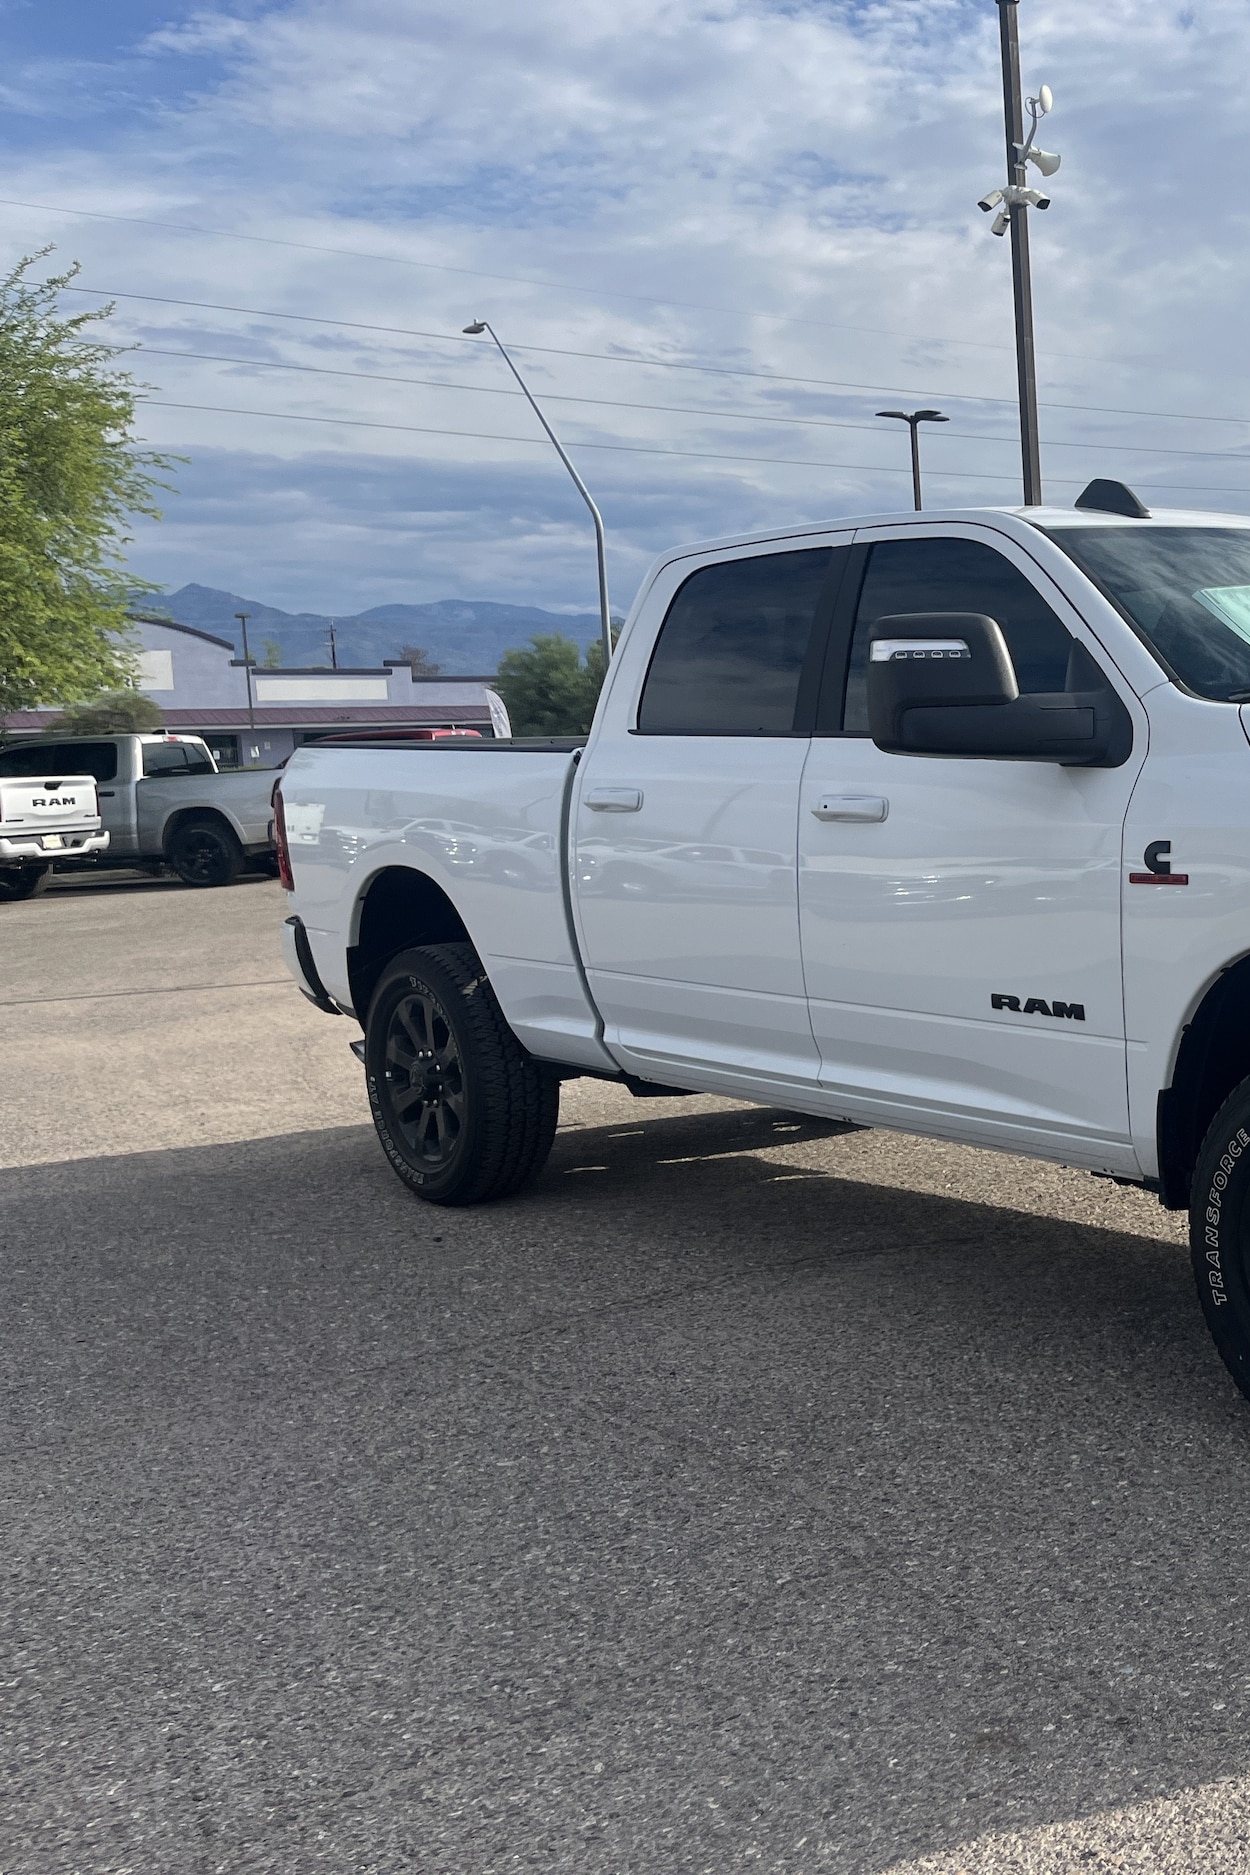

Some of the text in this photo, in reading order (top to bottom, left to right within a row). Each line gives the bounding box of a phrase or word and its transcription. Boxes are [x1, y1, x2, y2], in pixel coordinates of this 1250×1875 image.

[32, 797, 76, 807] RAM
[990, 993, 1086, 1021] RAM
[1205, 1128, 1250, 1306] TRANSFORCE
